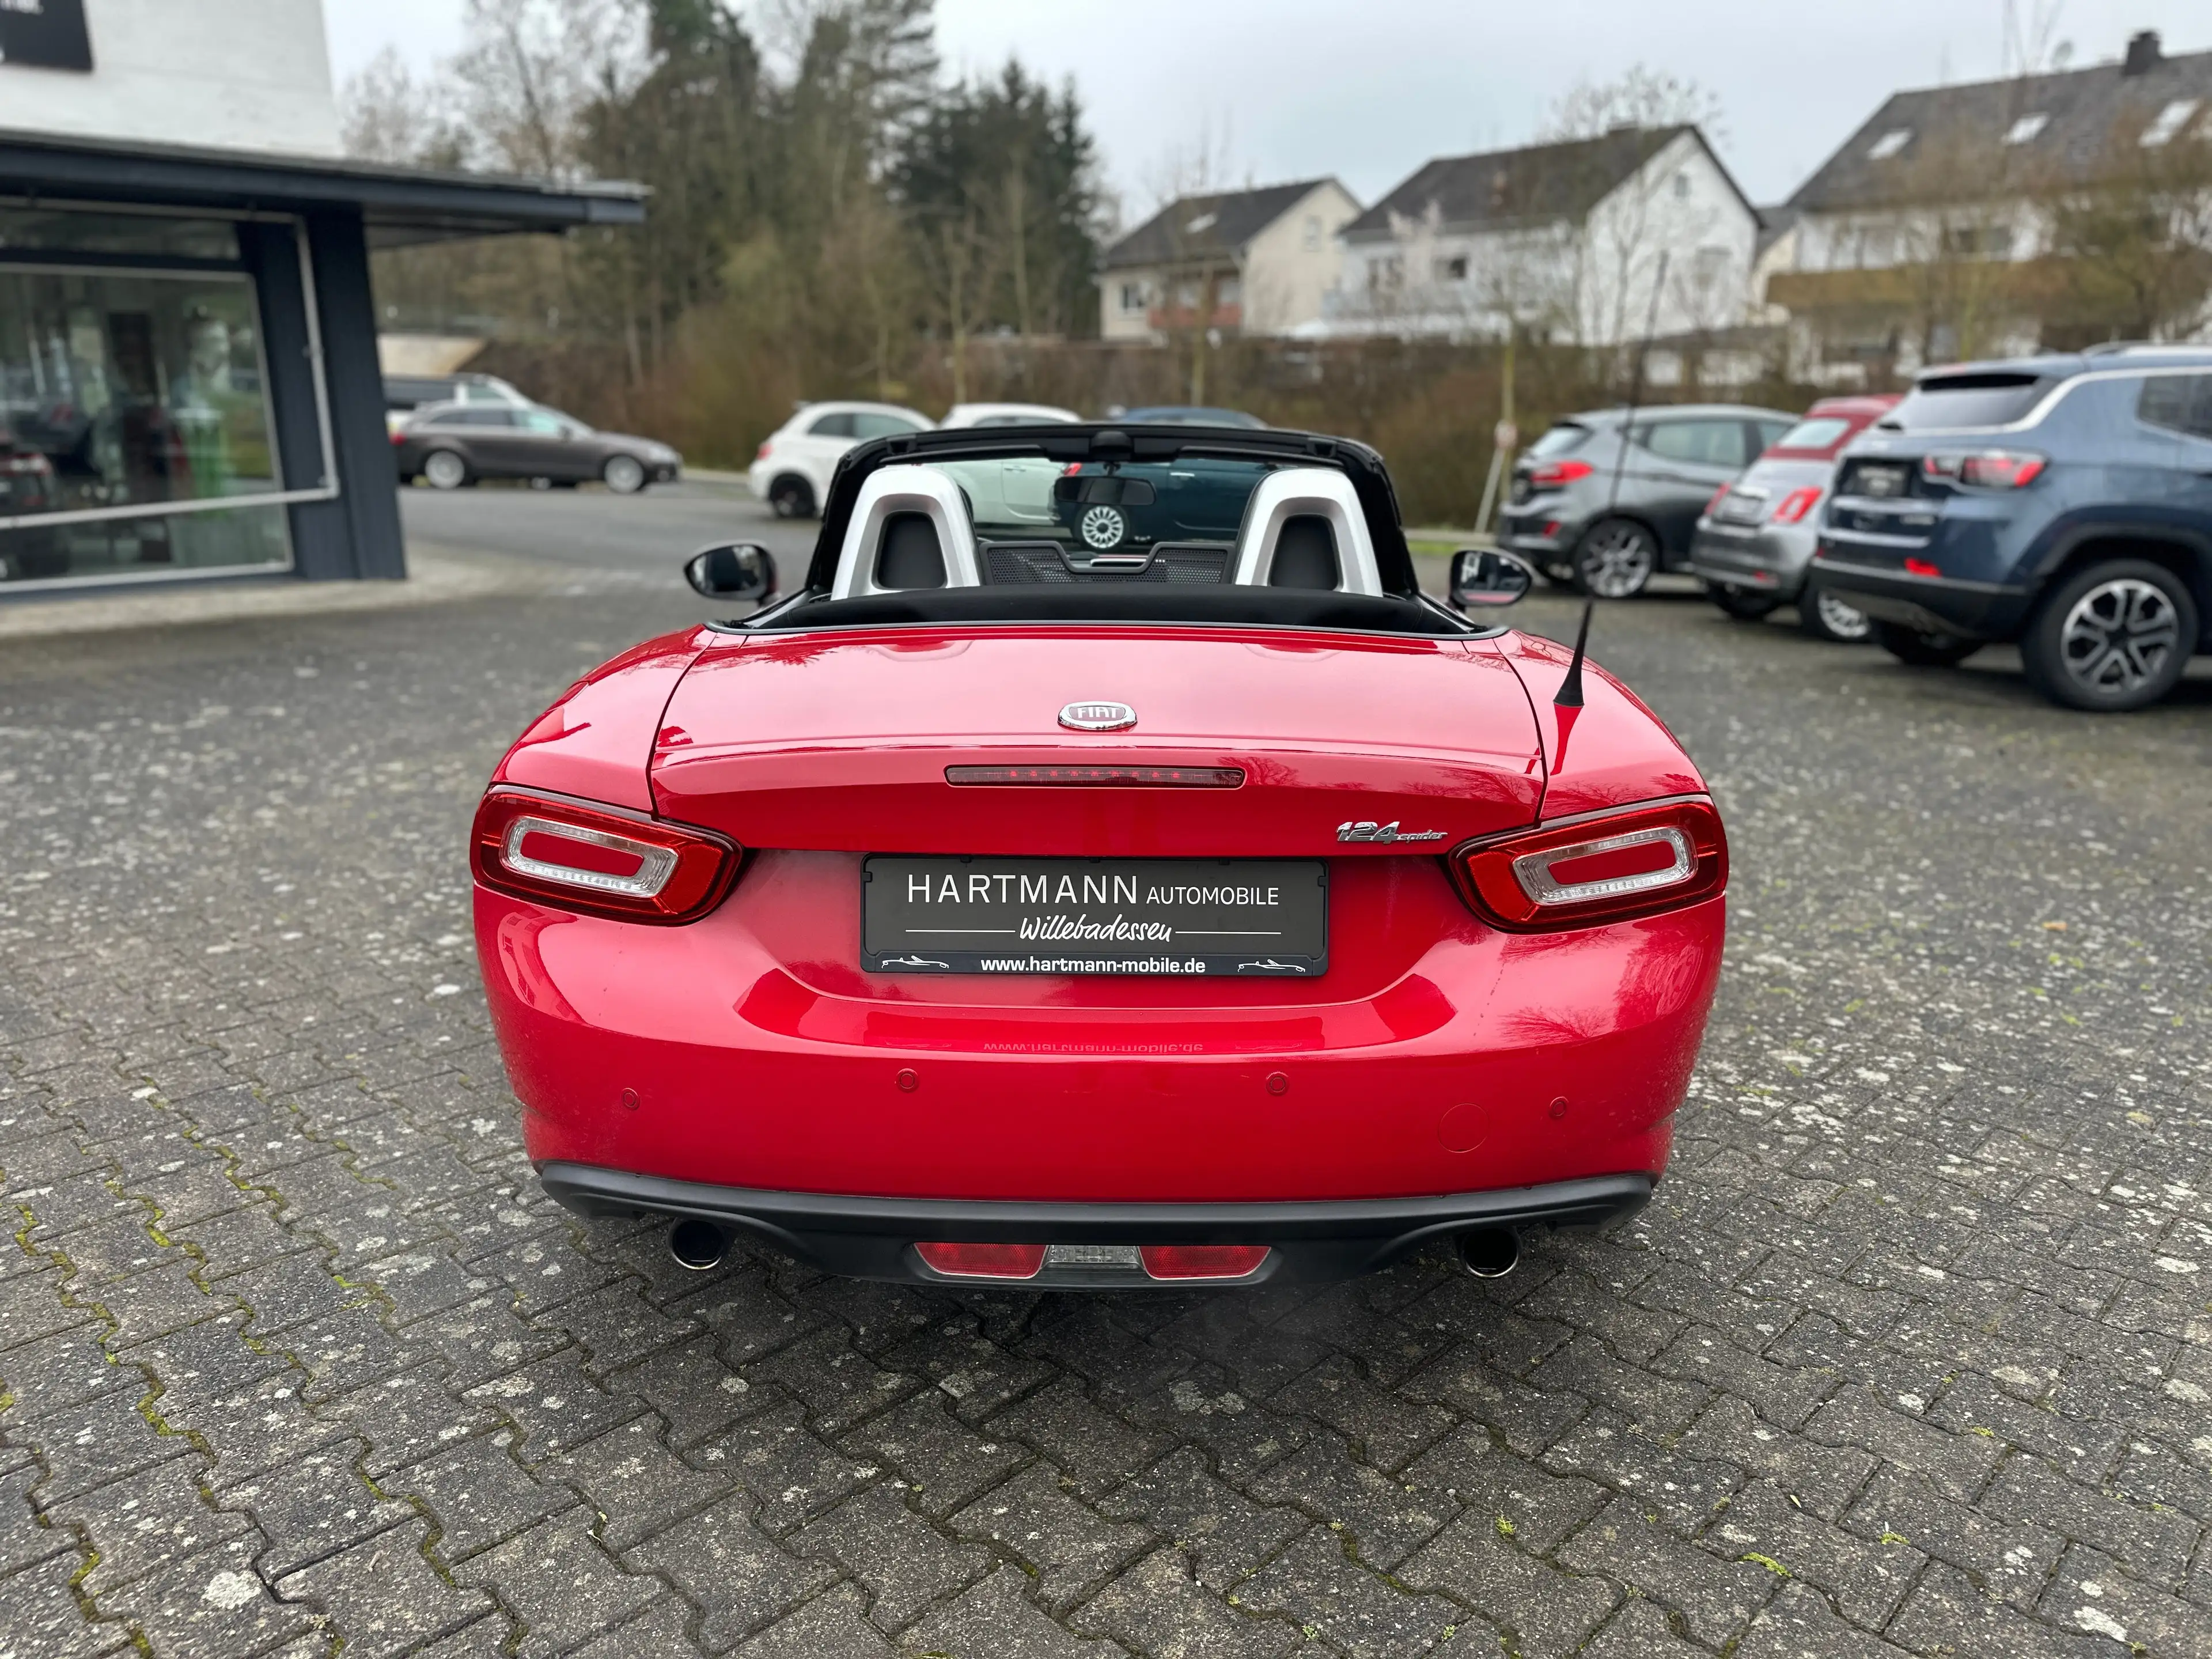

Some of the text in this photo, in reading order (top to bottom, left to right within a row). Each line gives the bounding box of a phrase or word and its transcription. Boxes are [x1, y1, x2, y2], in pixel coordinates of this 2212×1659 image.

[1077, 706, 1120, 719] FIAT
[1336, 821, 1448, 844] 124 spider
[908, 874, 1279, 906] HARTMANN AUTOMOBILE
[1019, 913, 1172, 942] Willebadessen
[980, 956, 1206, 974] www.hartmann-mobile.de
